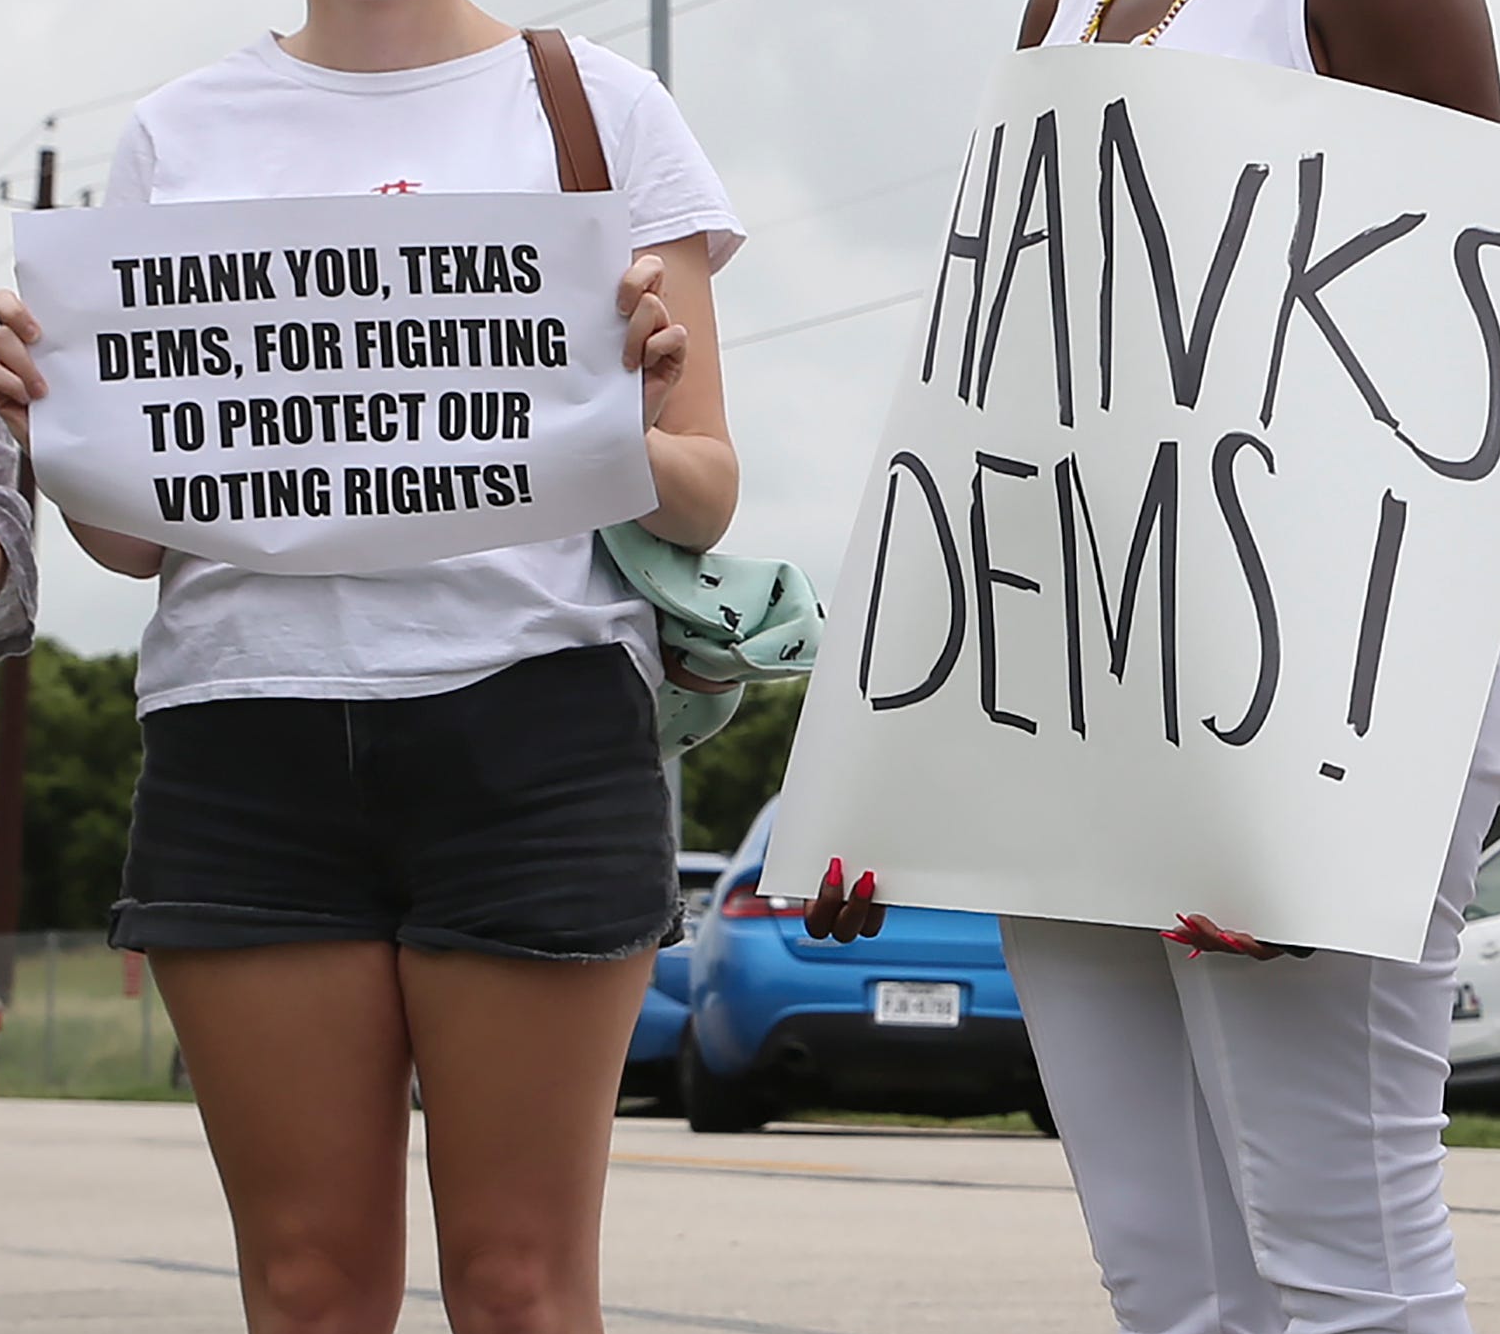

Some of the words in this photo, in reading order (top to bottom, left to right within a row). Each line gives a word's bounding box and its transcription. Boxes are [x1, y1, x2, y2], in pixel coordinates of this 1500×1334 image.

[111, 251, 277, 308] THANK
[283, 248, 392, 307] YOU,
[398, 244, 541, 295] TEXAS
[96, 326, 241, 389] DEMS,
[253, 322, 343, 373] FOR
[354, 317, 568, 369] FIGHTING
[142, 401, 205, 453] TO
[217, 393, 427, 449] PROTECT
[438, 391, 531, 442] OUR
[153, 469, 331, 523] VOTING
[344, 464, 531, 516] RIGHTS!
[859, 432, 1407, 781] DEMS!
